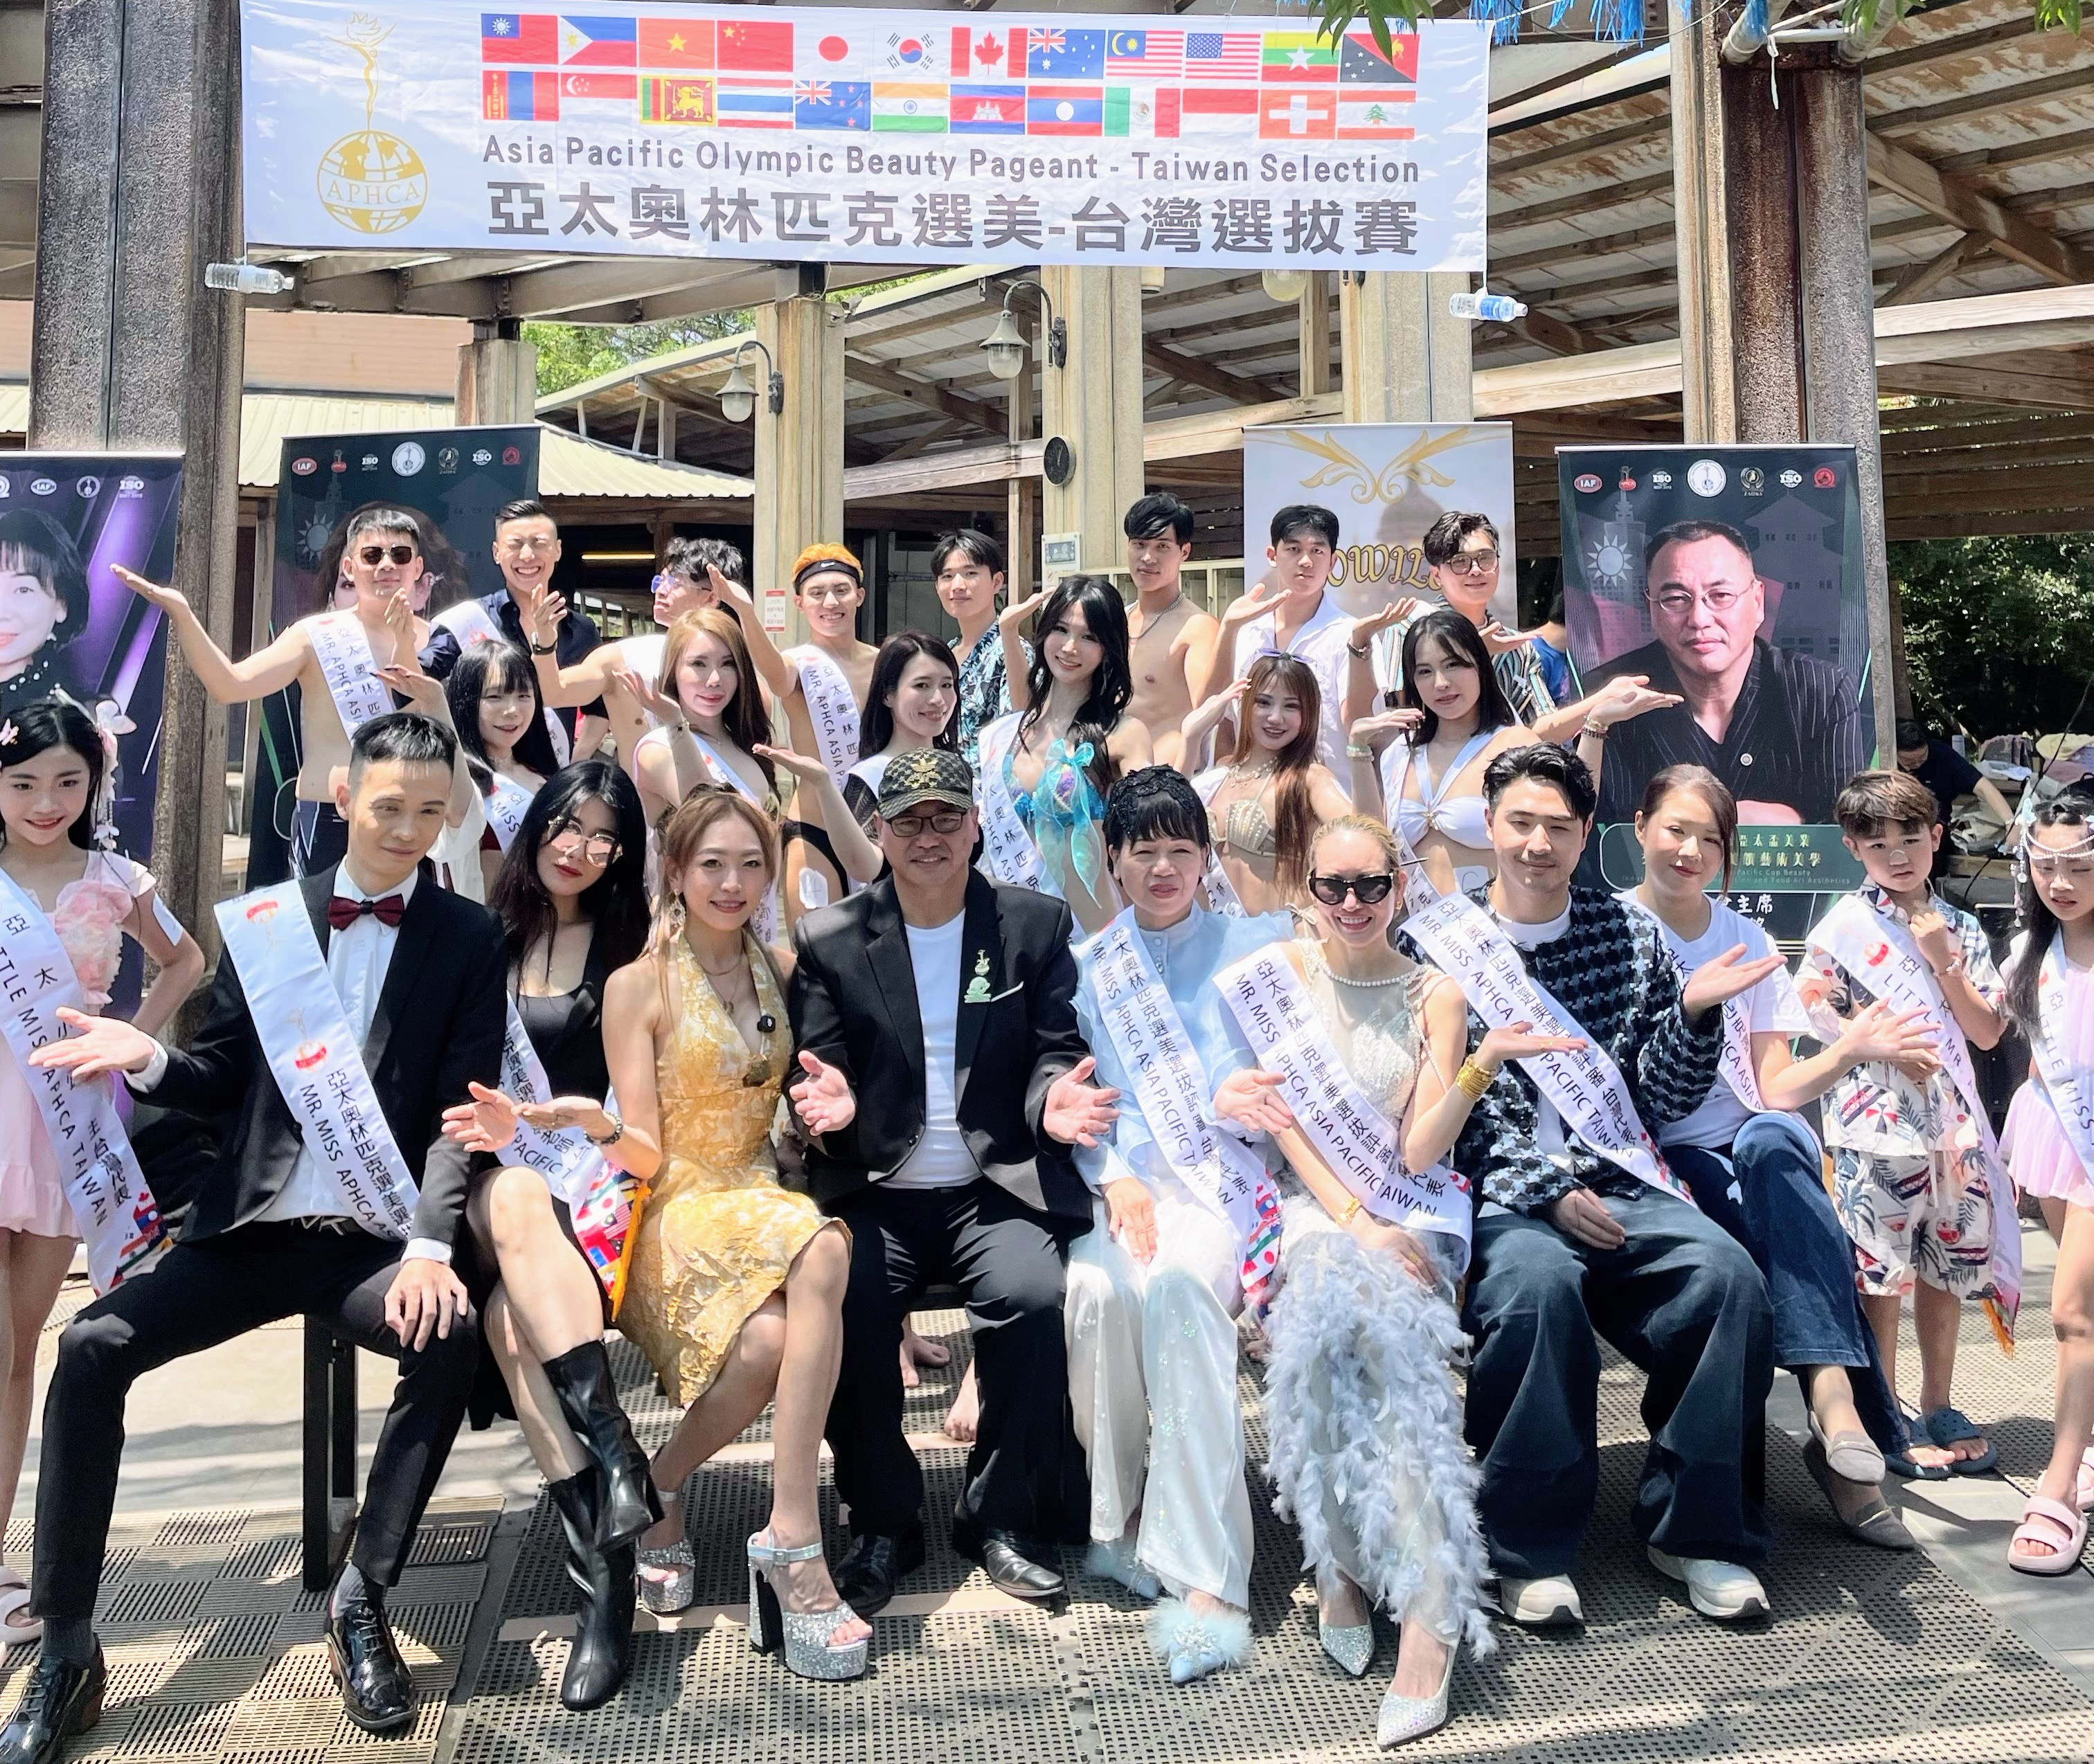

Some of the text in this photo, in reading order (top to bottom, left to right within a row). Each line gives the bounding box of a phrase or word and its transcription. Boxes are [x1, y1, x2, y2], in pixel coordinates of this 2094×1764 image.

[483, 135, 553, 165] Asia
[566, 137, 683, 169] Pacific
[696, 141, 834, 177] Olympic
[847, 145, 956, 183] Beauty
[970, 148, 1098, 184] Pageant
[1131, 152, 1248, 182] Taiwan
[1261, 153, 1420, 183] Selection
[325, 179, 423, 207] APHCA
[486, 180, 1420, 256] 亞太奧林匹克選美-台灣選拔賽
[296, 462, 312, 471] IAF
[361, 456, 379, 466] ISO
[472, 453, 492, 462] ISO
[119, 479, 145, 491] ISO
[1580, 479, 1597, 488] IAF
[1652, 474, 1672, 484] ISO
[1779, 474, 1802, 484] ISO
[321, 632, 336, 654] MR.
[331, 657, 355, 698] APHCA
[807, 669, 822, 692] MR.
[816, 695, 836, 737] APHCA
[828, 740, 843, 768] ASIA
[491, 801, 520, 833] MISS
[1418, 914, 1634, 1158] MR. MISS APHCA PACIFIC TAIWAN
[1091, 939, 1235, 1205] MR. MISS APHCA ASIA PACIFIC TAIWAN
[1233, 972, 1256, 1005] MR.
[1249, 1003, 1282, 1043] MISS
[1273, 1045, 1309, 1101] APHCA
[1305, 1100, 1335, 1137] ASIA
[1330, 1135, 1382, 1192] PACIFIC
[1738, 1069, 1755, 1105] ASIA
[17, 1008, 48, 1048] MIS
[42, 1068, 76, 1140] APHCA
[73, 1141, 108, 1227] TAIWAN
[2061, 1079, 2094, 1131] MISS
[300, 1083, 322, 1119] MR.
[314, 1119, 343, 1162] MISS
[336, 1169, 377, 1223] APHCA
[511, 1133, 564, 1174] PACIFIC
